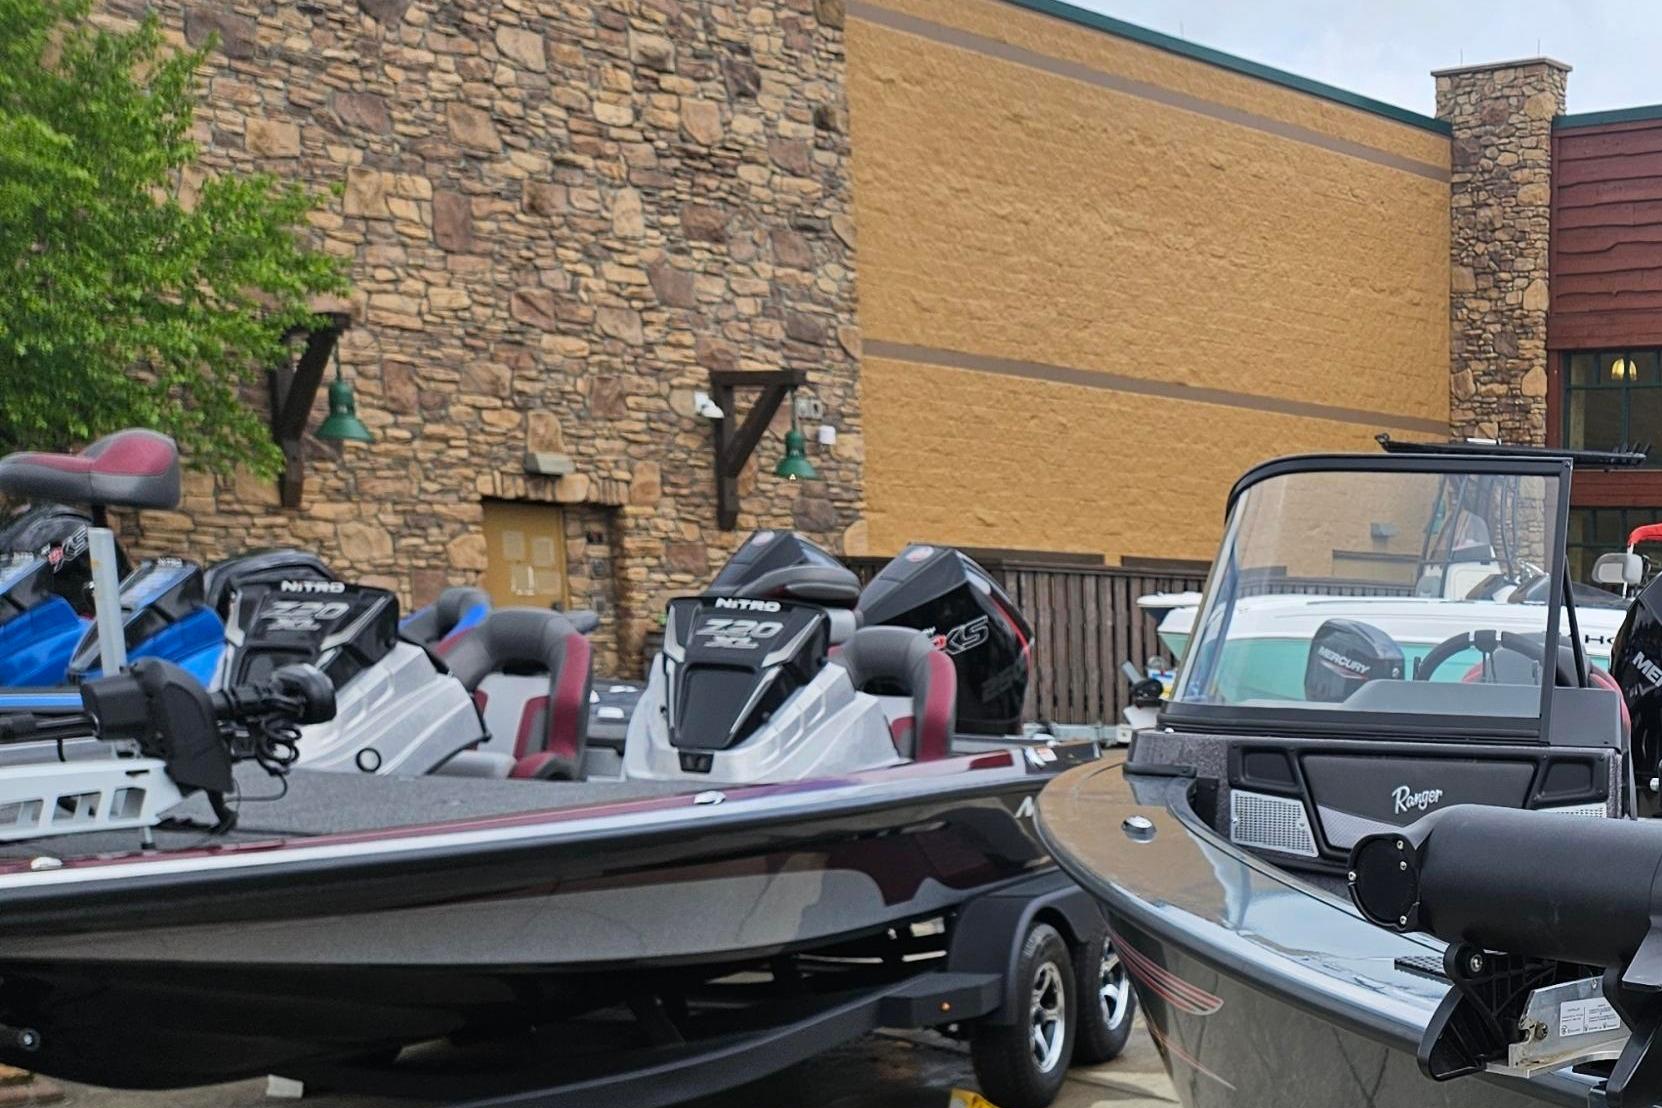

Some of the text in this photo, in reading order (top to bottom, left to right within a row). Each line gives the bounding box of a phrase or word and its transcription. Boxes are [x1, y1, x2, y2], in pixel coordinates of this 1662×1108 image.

[281, 580, 346, 593] NITRO
[715, 597, 781, 612] NITRO
[696, 618, 784, 638] Z20
[1318, 645, 1371, 674] MERCURY
[1391, 785, 1443, 815] Ranger
